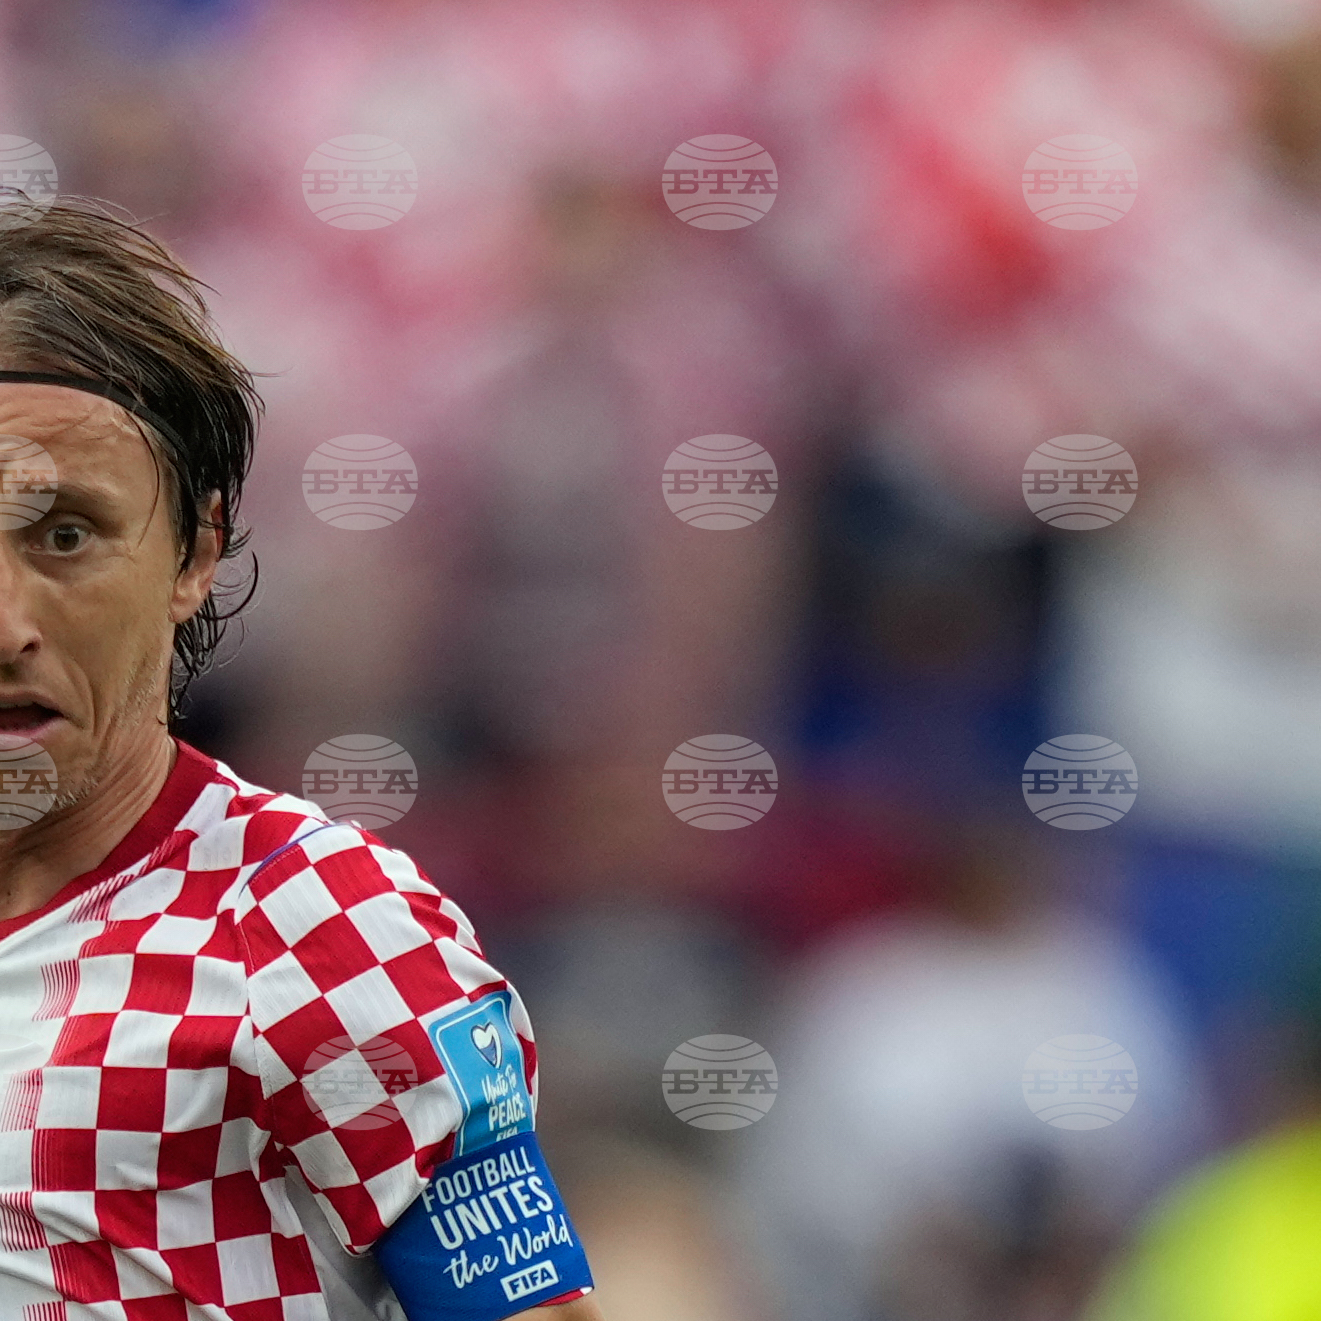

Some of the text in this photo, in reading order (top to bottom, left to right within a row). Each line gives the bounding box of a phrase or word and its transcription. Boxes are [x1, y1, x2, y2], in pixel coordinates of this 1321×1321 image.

[422, 1146, 536, 1213] FOOTBALL
[430, 1175, 553, 1250] UNITES
[443, 1214, 573, 1289] the World
[508, 1267, 556, 1298] FIFA
